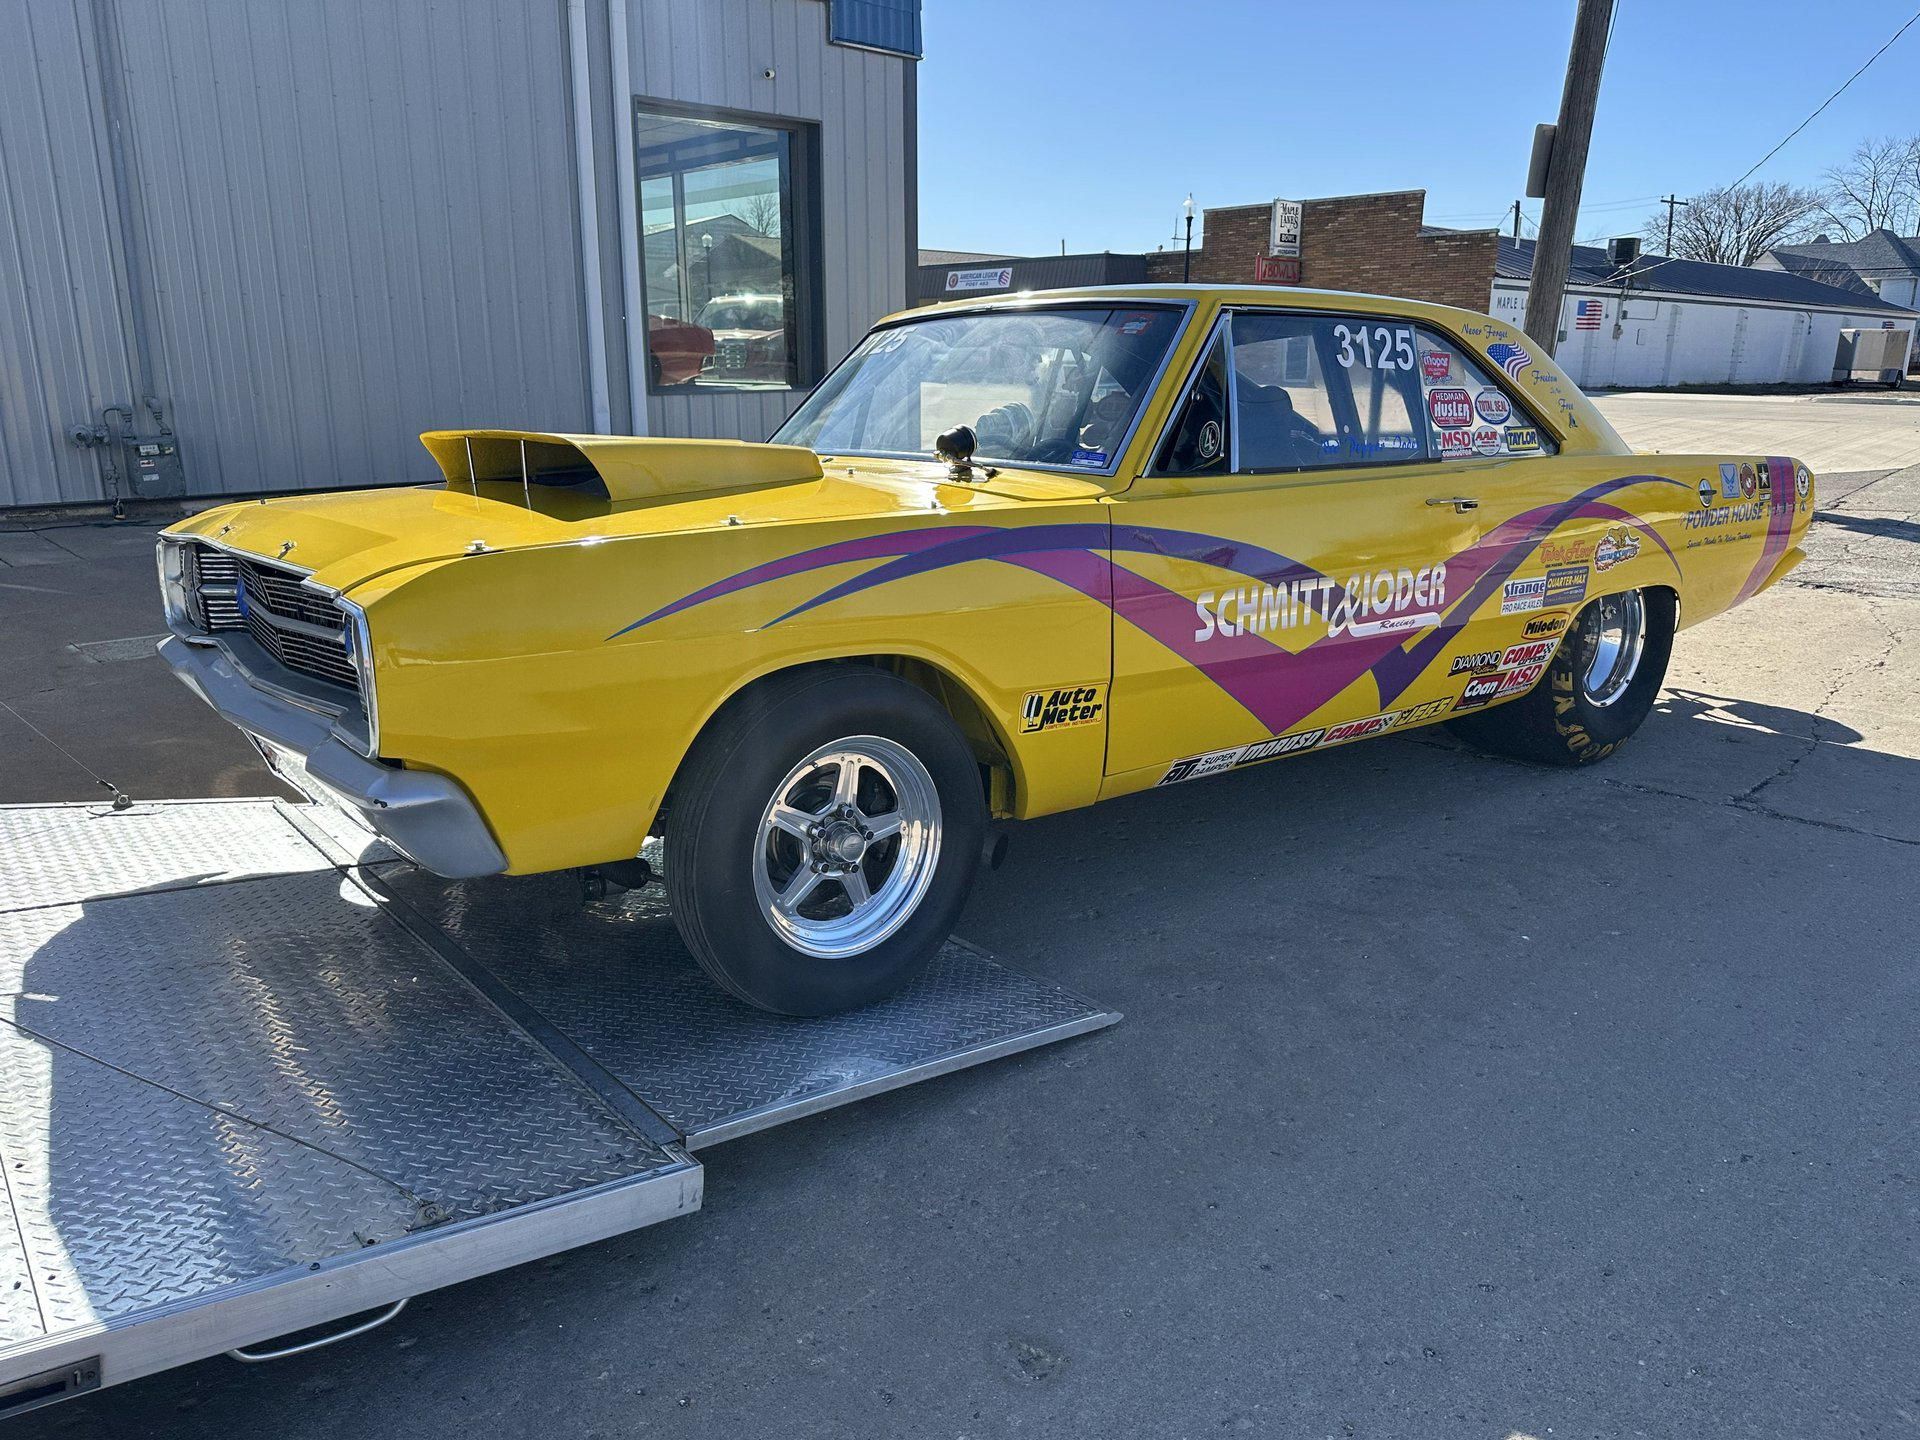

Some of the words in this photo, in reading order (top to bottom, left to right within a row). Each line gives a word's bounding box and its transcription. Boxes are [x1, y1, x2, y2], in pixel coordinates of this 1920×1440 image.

[1280, 203, 1299, 215] MAPLE
[1280, 214, 1299, 229] LANES
[1281, 234, 1296, 242] BOWL
[1267, 263, 1292, 279] BOWL
[1497, 297, 1517, 309] MAPLE
[1461, 324, 1481, 336] Never
[1483, 325, 1508, 340] Forget
[1334, 325, 1414, 371] 3125
[1531, 370, 1558, 385] Freedom
[1436, 392, 1464, 401] HEDMAN
[1434, 402, 1470, 421] HUSLER
[1478, 400, 1494, 412] TOTAL
[1494, 400, 1508, 412] SEAL
[1558, 398, 1574, 413] Free
[1441, 431, 1471, 448] MSD
[1507, 431, 1537, 445] TAYLOR
[1685, 506, 1730, 530] POWDER
[1731, 501, 1765, 523] HOUSE
[1504, 580, 1546, 598] Strange
[1195, 577, 1336, 642] SCHMITT
[1502, 602, 1513, 613] PRO
[1513, 600, 1528, 611] RACE
[1379, 618, 1416, 631] Racing
[1524, 619, 1567, 635] Milodon
[1452, 652, 1501, 671] DIAMOND
[1502, 643, 1546, 665] COMP
[1500, 664, 1543, 690] MSD
[1464, 680, 1499, 697] Coan
[1046, 688, 1097, 707] Auto
[1041, 704, 1102, 725] Meter
[1045, 722, 1070, 731] COMPETITION
[1323, 718, 1383, 742] COMP
[1239, 729, 1325, 763] MOROSO
[1202, 752, 1237, 766] SUPER
[1190, 761, 1234, 776] DAMPER
